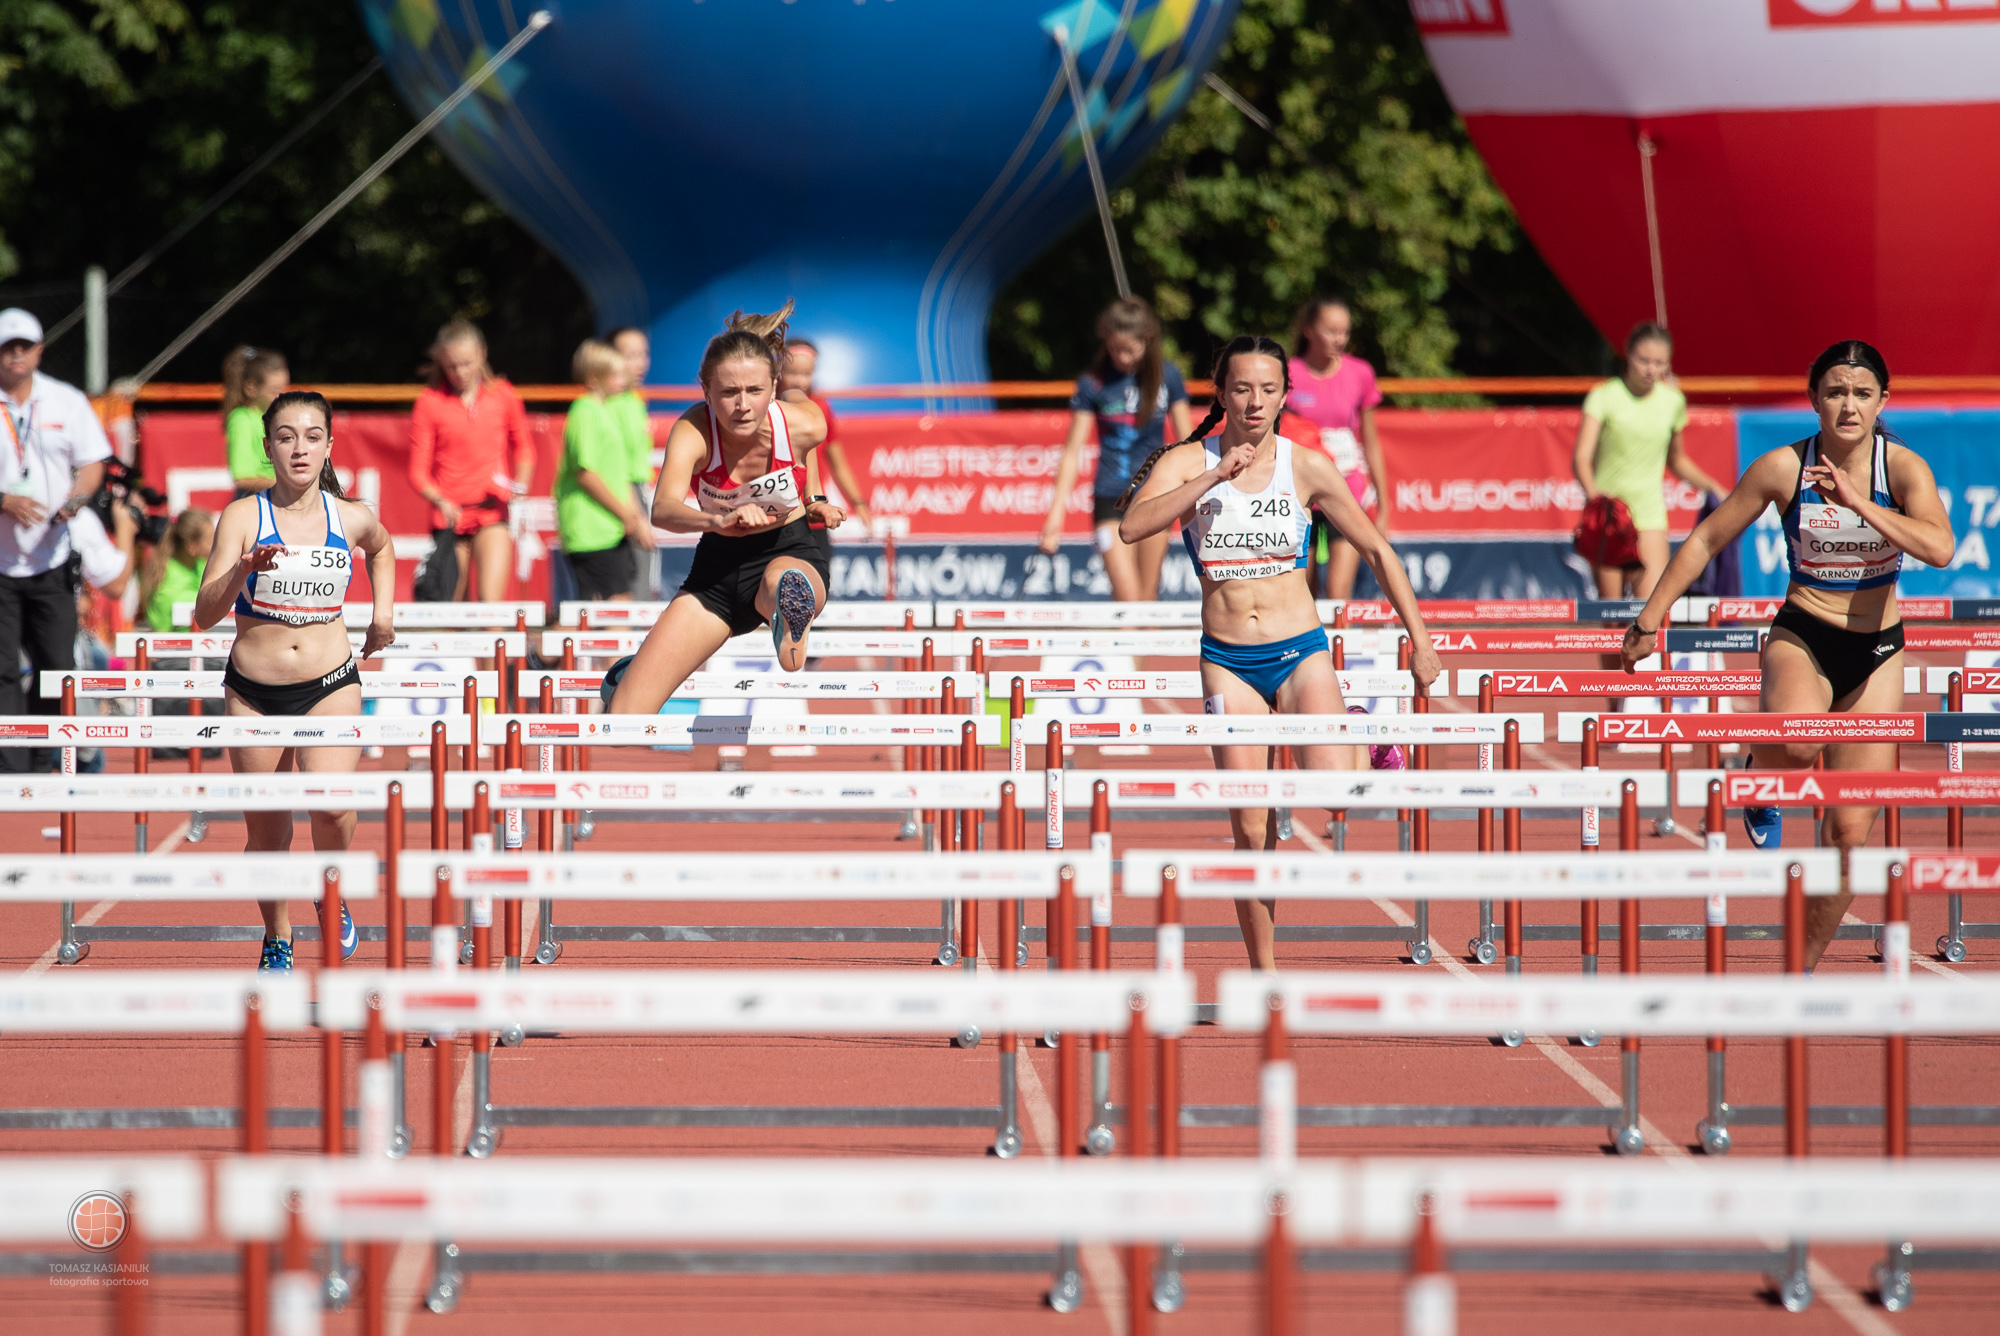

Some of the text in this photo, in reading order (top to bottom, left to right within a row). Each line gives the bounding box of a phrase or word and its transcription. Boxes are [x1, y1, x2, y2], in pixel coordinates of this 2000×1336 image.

[749, 472, 789, 498] 295
[1251, 498, 1291, 518] 248
[1810, 519, 1839, 529] ORLEN
[1204, 532, 1291, 551] SZCZĘSNA
[1809, 540, 1891, 554] GOZDERA
[310, 550, 347, 569] 558
[1213, 566, 1257, 579] TARNÓW
[1260, 563, 1282, 576] 2019
[1816, 568, 1860, 579] TARNÓW
[271, 580, 335, 597] BLUTKO
[1722, 602, 1778, 619] PZLA
[322, 666, 347, 688] NIKE
[1108, 680, 1144, 689] ORLEN
[1498, 675, 1569, 692] PZLA
[1580, 684, 1605, 692] MAŁY
[1606, 684, 1654, 692] MEMORIAŁ
[1655, 683, 1698, 691] JANUSZA
[1655, 675, 1720, 683] MISTRZOSTWA
[87, 726, 126, 737] ORLEN
[1604, 719, 1915, 738] PZLA MAŁY MEMORIAŁ JANUSZA KUSOCIŃSKIEGO
[1782, 719, 1915, 727] MISTRZOSTWA POLSKI U16
[196, 726, 220, 738] 4F
[293, 730, 325, 738] 4MOVE
[1730, 776, 1825, 801] PZLA
[1048, 789, 1060, 832] polanik
